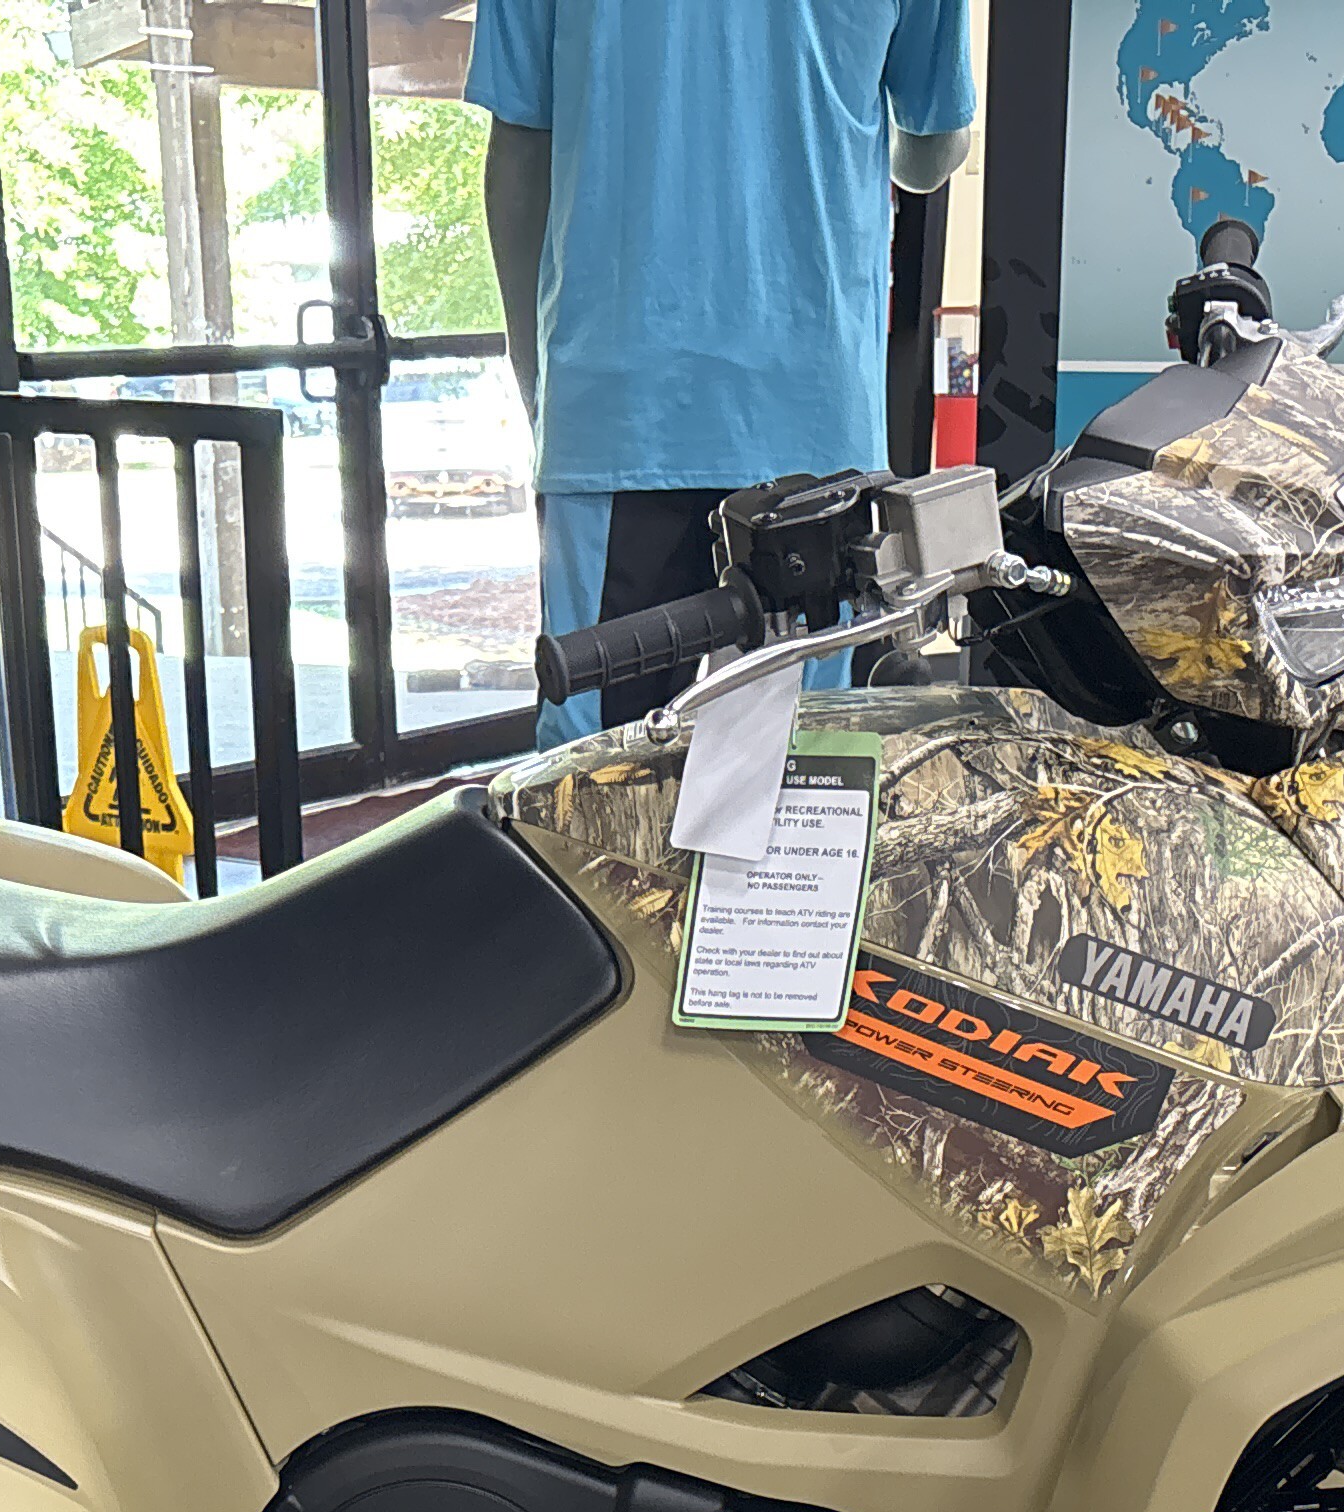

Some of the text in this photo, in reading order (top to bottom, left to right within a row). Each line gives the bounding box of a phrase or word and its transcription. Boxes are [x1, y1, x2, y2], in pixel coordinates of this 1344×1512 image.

[786, 774, 844, 787] USE MODEL
[785, 805, 863, 818] RECREATIONAL
[802, 818, 825, 829] USE.
[766, 845, 782, 856] OR
[783, 846, 820, 857] UNDER
[821, 847, 844, 858] AGE
[746, 871, 793, 881] OPERATOR
[747, 882, 819, 892] NO PASSENGERS
[702, 904, 851, 920] Training courses to teach ATV riding are
[742, 917, 757, 926] For
[757, 917, 800, 928] information
[800, 920, 829, 929] contact
[830, 921, 848, 931] your
[696, 946, 844, 960] Check with your dealer to find out about
[694, 957, 714, 966] state
[724, 958, 743, 967] local
[762, 960, 799, 972] regarding
[799, 961, 818, 970] ATV
[690, 987, 707, 997] This
[708, 989, 728, 1000] hang
[728, 989, 741, 1000] tag
[750, 991, 763, 999] not
[764, 991, 772, 1000] to
[773, 991, 784, 1000] be
[784, 992, 818, 1001] removed
[1081, 940, 1254, 1046] YAMAHA
[688, 999, 713, 1008] before
[853, 969, 1139, 1099] KODIAK
[845, 1019, 1076, 1117] POWER STEERING
